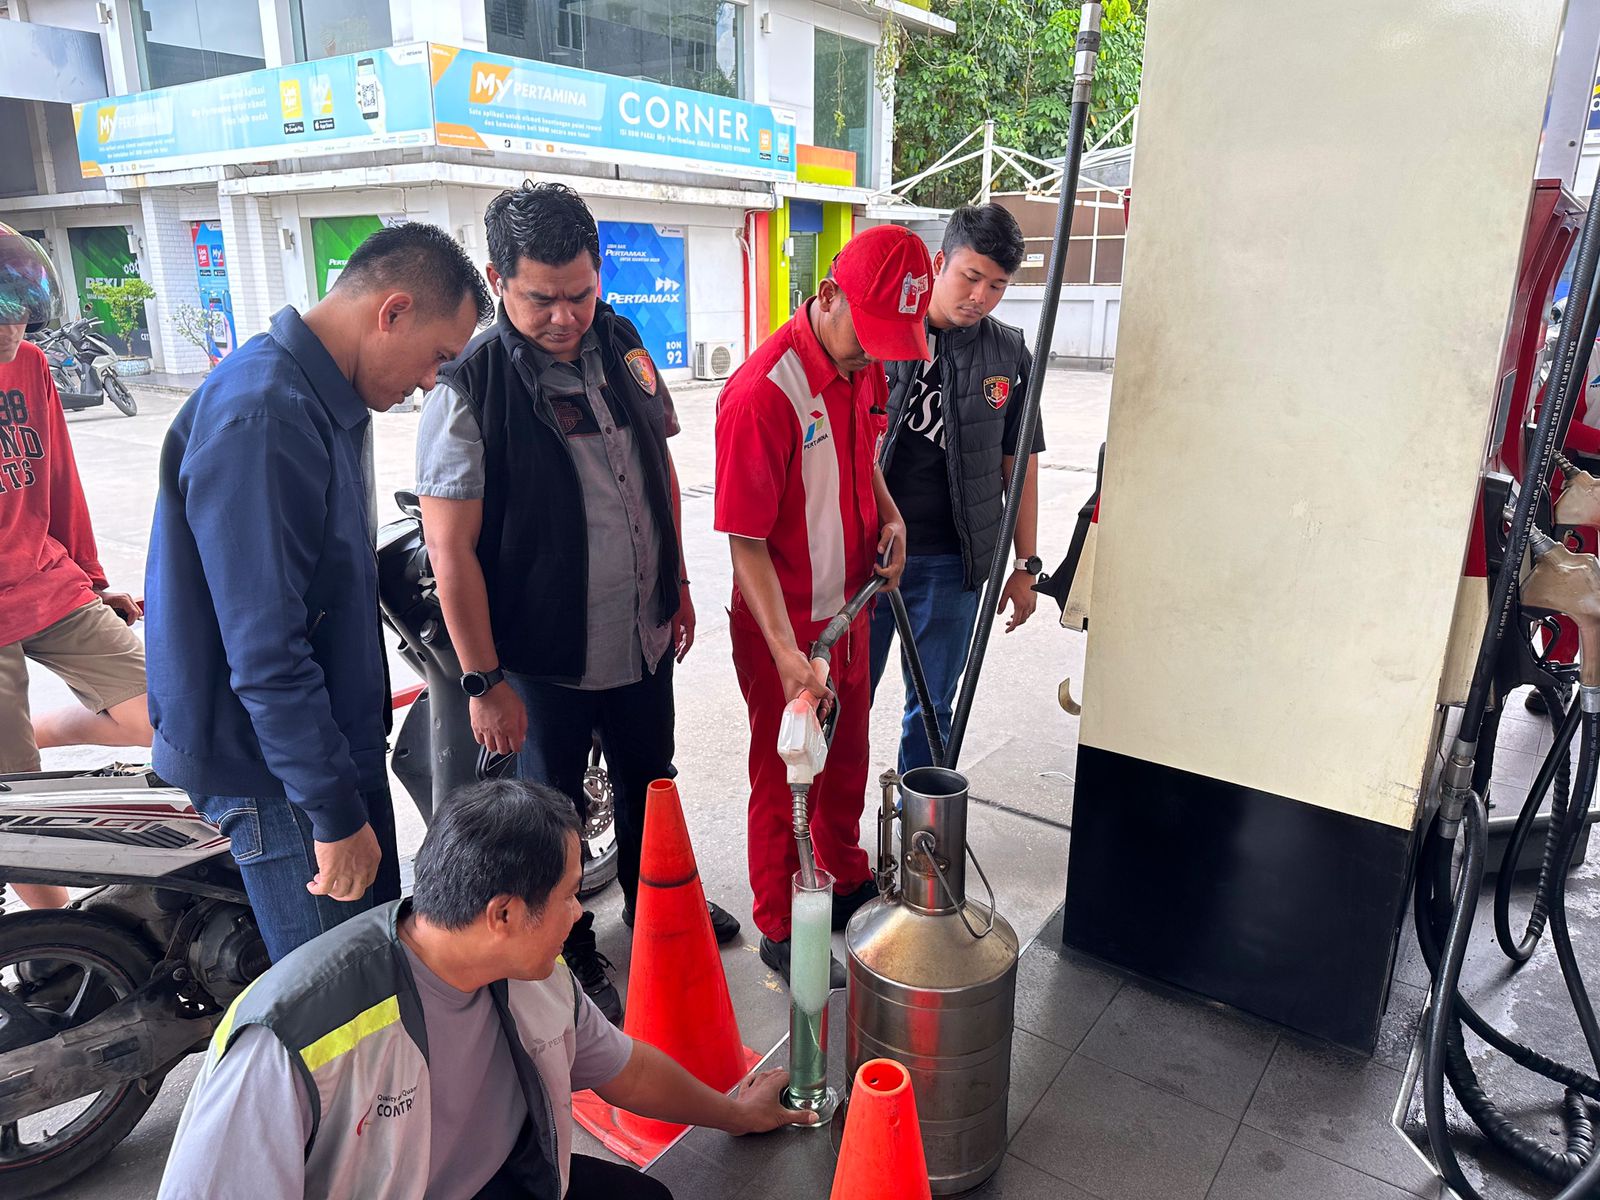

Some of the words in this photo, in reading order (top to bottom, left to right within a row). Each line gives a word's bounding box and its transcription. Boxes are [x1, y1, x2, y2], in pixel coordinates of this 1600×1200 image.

[474, 70, 511, 103] My
[512, 81, 587, 107] PERTAMINA
[619, 91, 750, 142] CORNER
[99, 114, 117, 140] My
[656, 133, 665, 142] My
[667, 135, 695, 146] Pertamina
[605, 249, 647, 257] PERTAMAX
[605, 292, 680, 304] PERTAMAX
[666, 342, 682, 350] RON
[1566, 340, 1576, 357] SAE
[667, 351, 683, 364] 92
[1563, 359, 1571, 372] 100
[1560, 374, 1568, 384] R1
[1554, 386, 1564, 410] AT/EN
[1550, 412, 1558, 425] 853
[1546, 427, 1554, 442] 1SN
[1543, 444, 1550, 455] DN
[1531, 488, 1538, 500] WP
[1523, 517, 1531, 531] BAR
[1503, 595, 1511, 609] BAR
[547, 1036, 564, 1048] PER
[377, 1095, 416, 1118] CONTR
